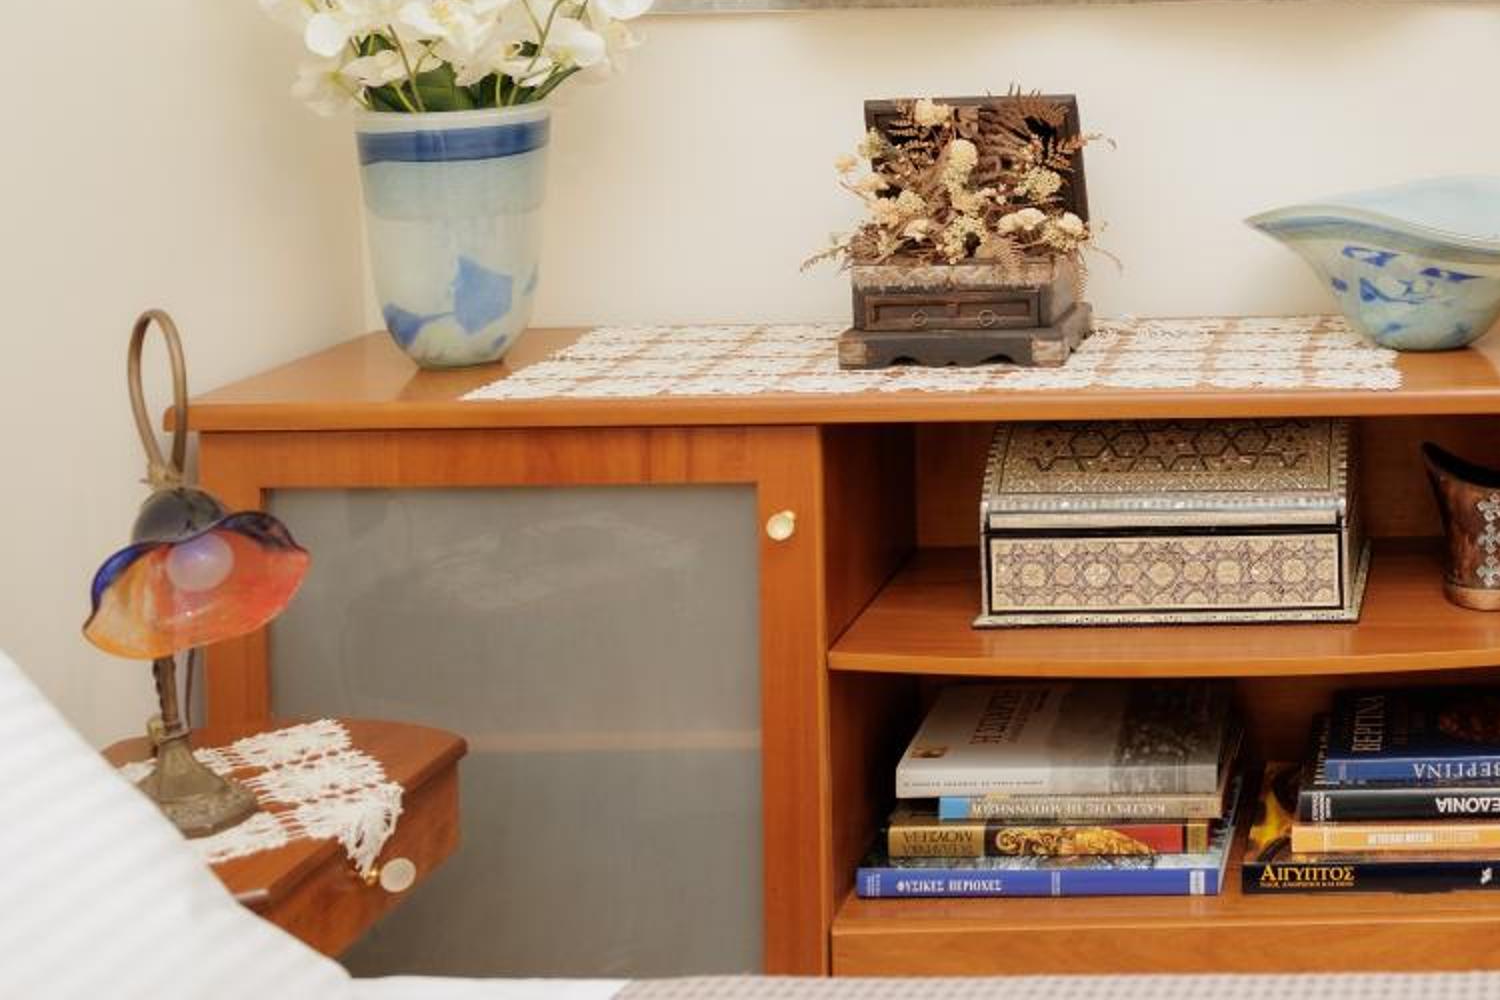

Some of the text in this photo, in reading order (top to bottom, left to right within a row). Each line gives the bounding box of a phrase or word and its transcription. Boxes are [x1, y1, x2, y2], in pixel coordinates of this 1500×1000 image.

[1259, 863, 1355, 881] ΑΙΓΥΠΤΟΣ
[896, 878, 1002, 892] ΦΥΣΙΚΕΣ ΠΕΡΙΟΧΕΣ
